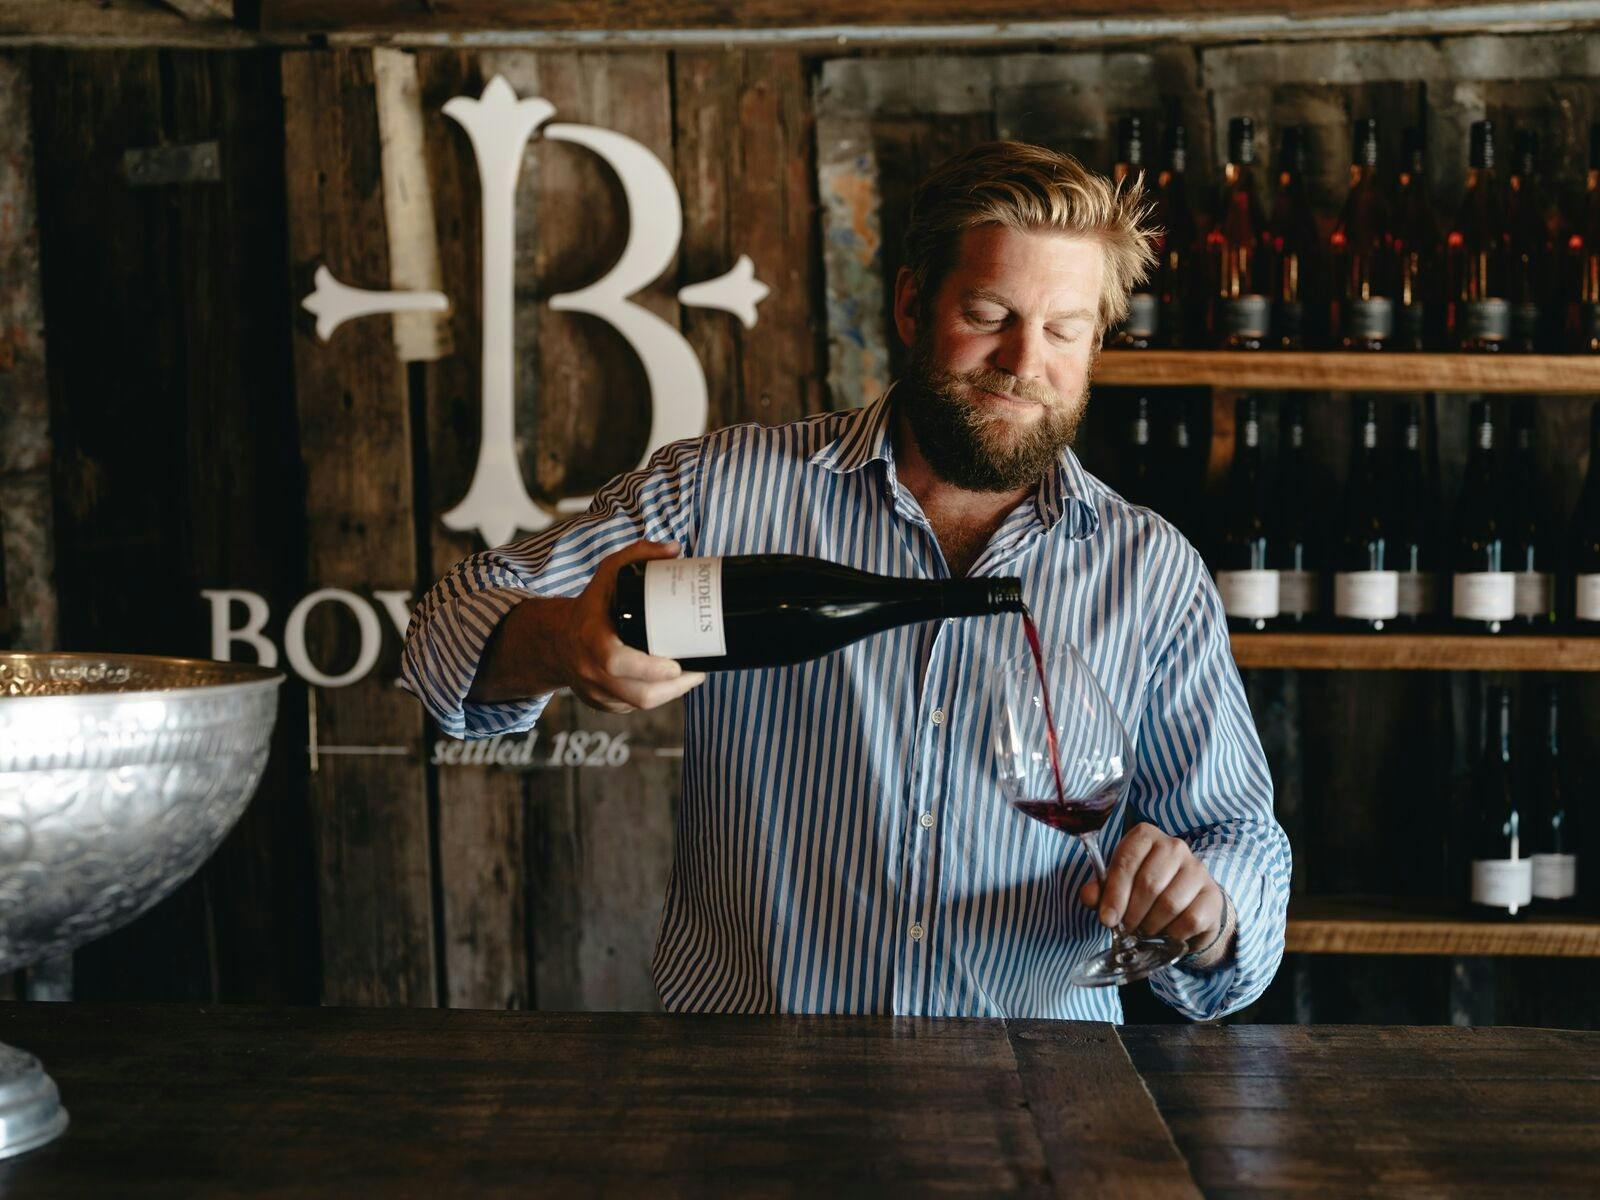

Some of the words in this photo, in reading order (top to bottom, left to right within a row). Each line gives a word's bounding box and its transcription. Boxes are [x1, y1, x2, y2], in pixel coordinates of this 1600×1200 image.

[441, 74, 709, 548] B
[430, 729, 540, 766] settled
[545, 730, 632, 767] 1826
